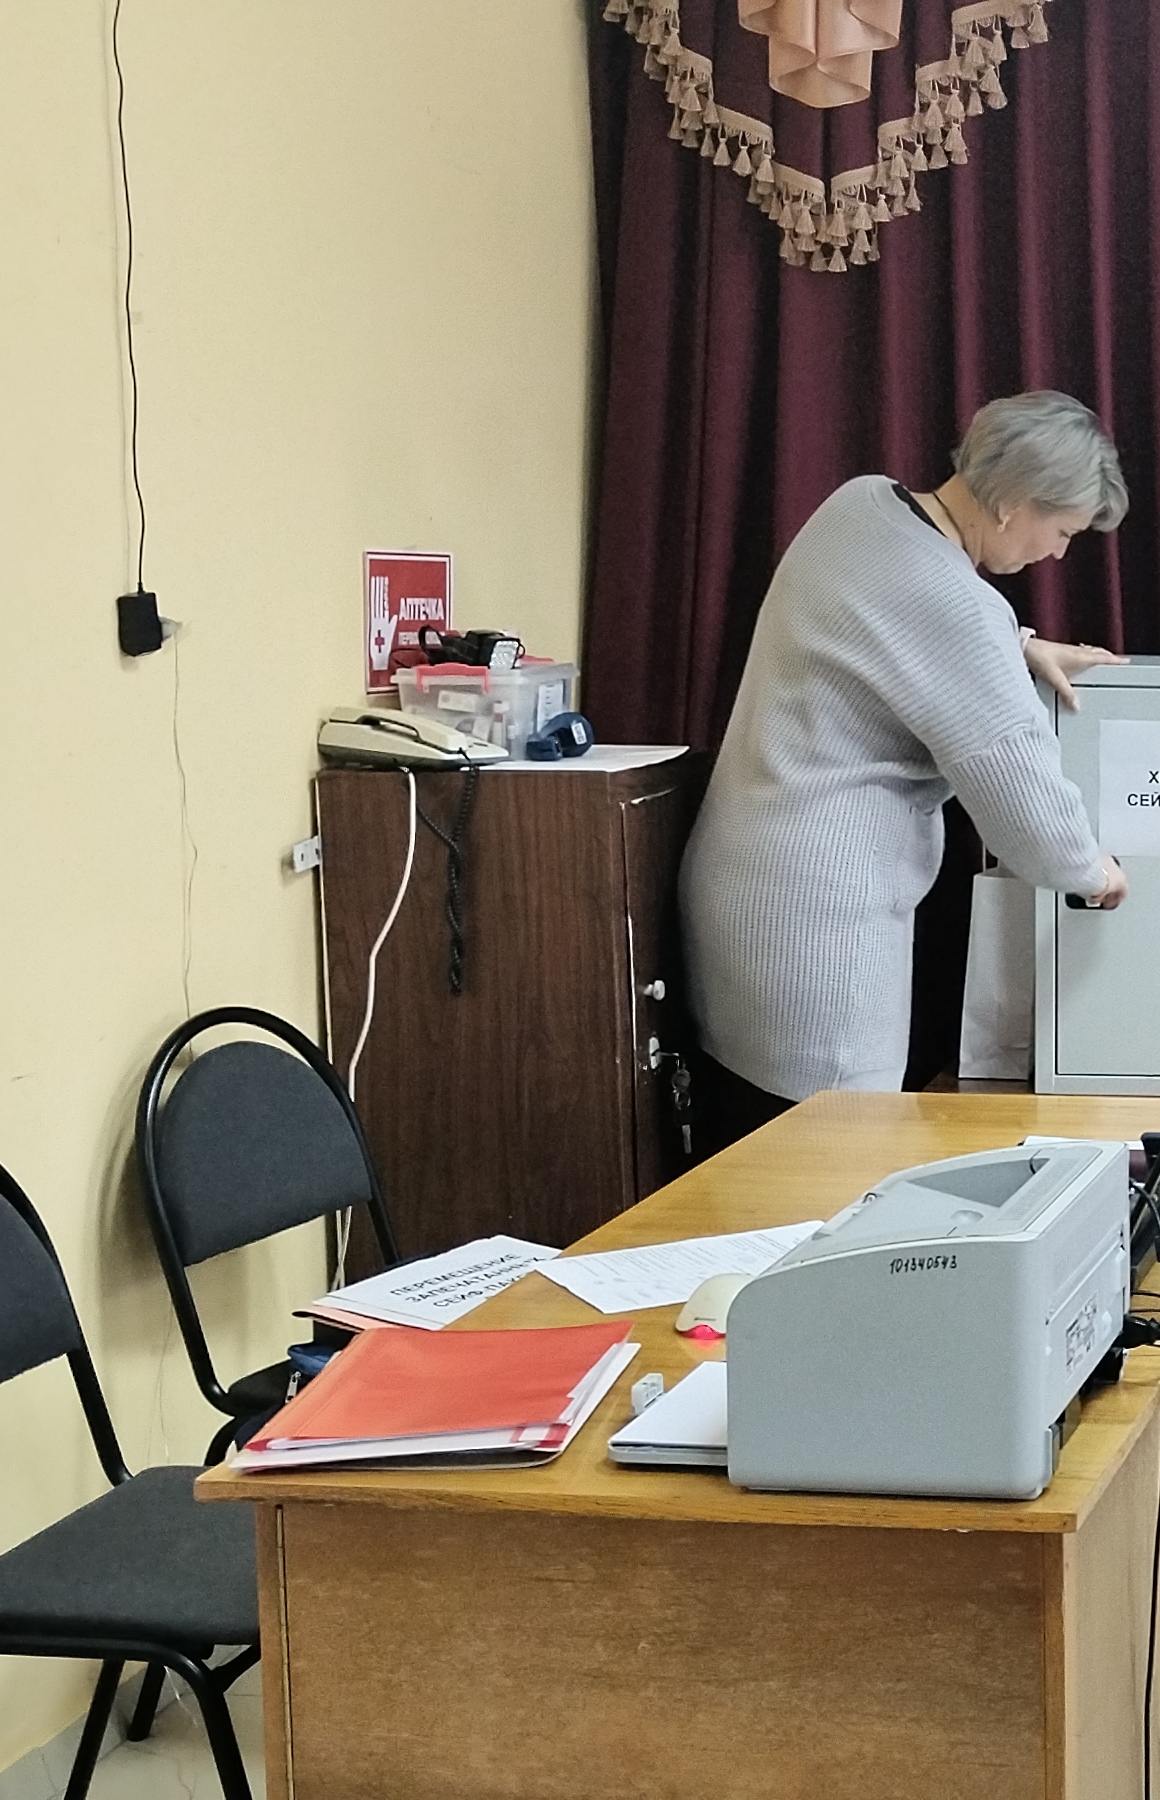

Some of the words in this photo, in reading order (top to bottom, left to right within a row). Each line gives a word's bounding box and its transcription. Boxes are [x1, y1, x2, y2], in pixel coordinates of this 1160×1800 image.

[399, 597, 444, 620] АПТЕЧКА
[390, 1253, 522, 1296] ПЕРЕМЕЩЕНИЕ
[405, 1256, 546, 1303] ЗАПЕЧАТАННЫХ
